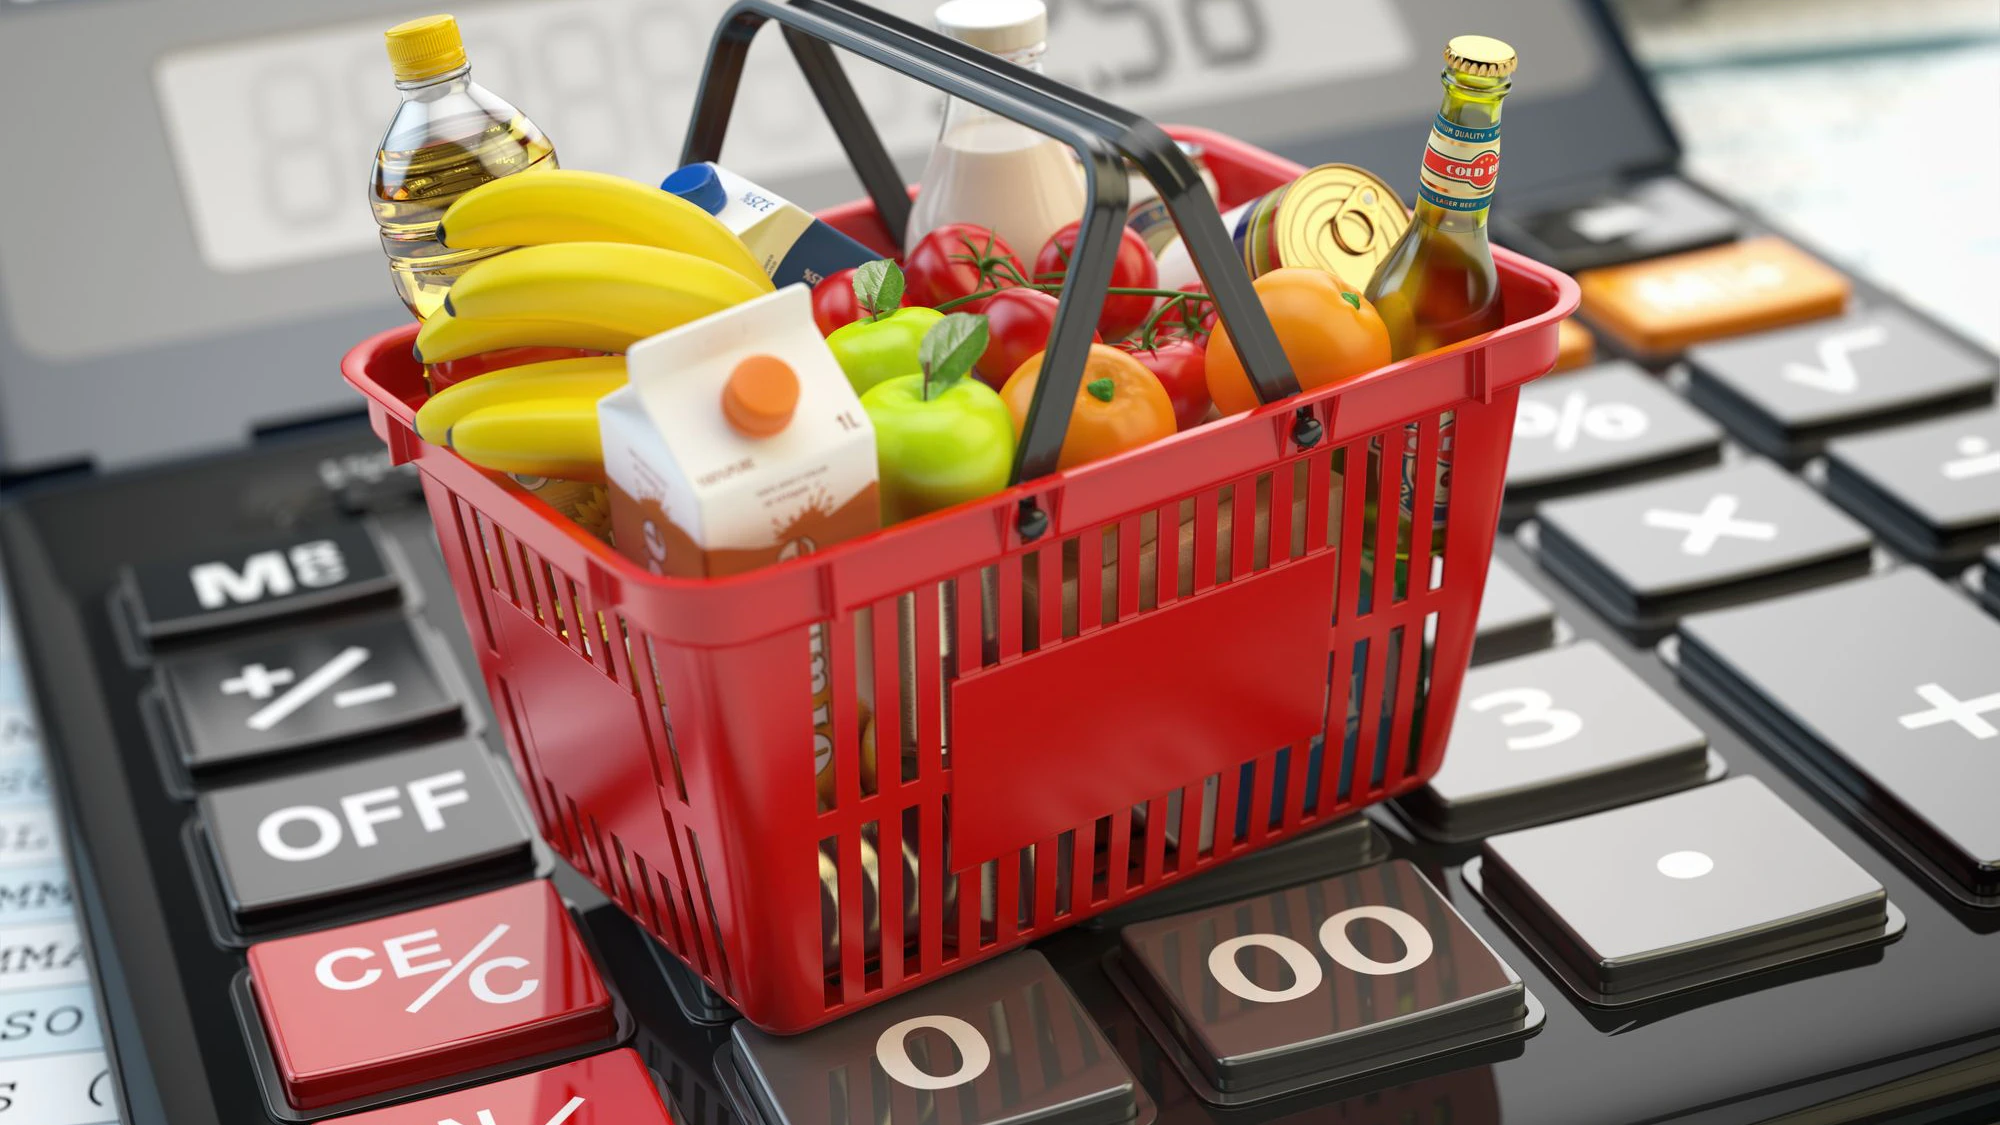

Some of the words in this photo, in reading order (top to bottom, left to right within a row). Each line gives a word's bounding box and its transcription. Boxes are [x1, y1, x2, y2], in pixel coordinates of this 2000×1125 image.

[1455, 128, 1485, 140] QUALITY
[1435, 195, 1458, 207] LAGER
[1446, 164, 1485, 178] COLD
[1487, 162, 1500, 175] BE
[1468, 687, 1584, 750] 3
[257, 769, 470, 862] OFF
[314, 923, 540, 1014] CE/C
[1207, 904, 1434, 1003] 00
[875, 1013, 991, 1091] 0
